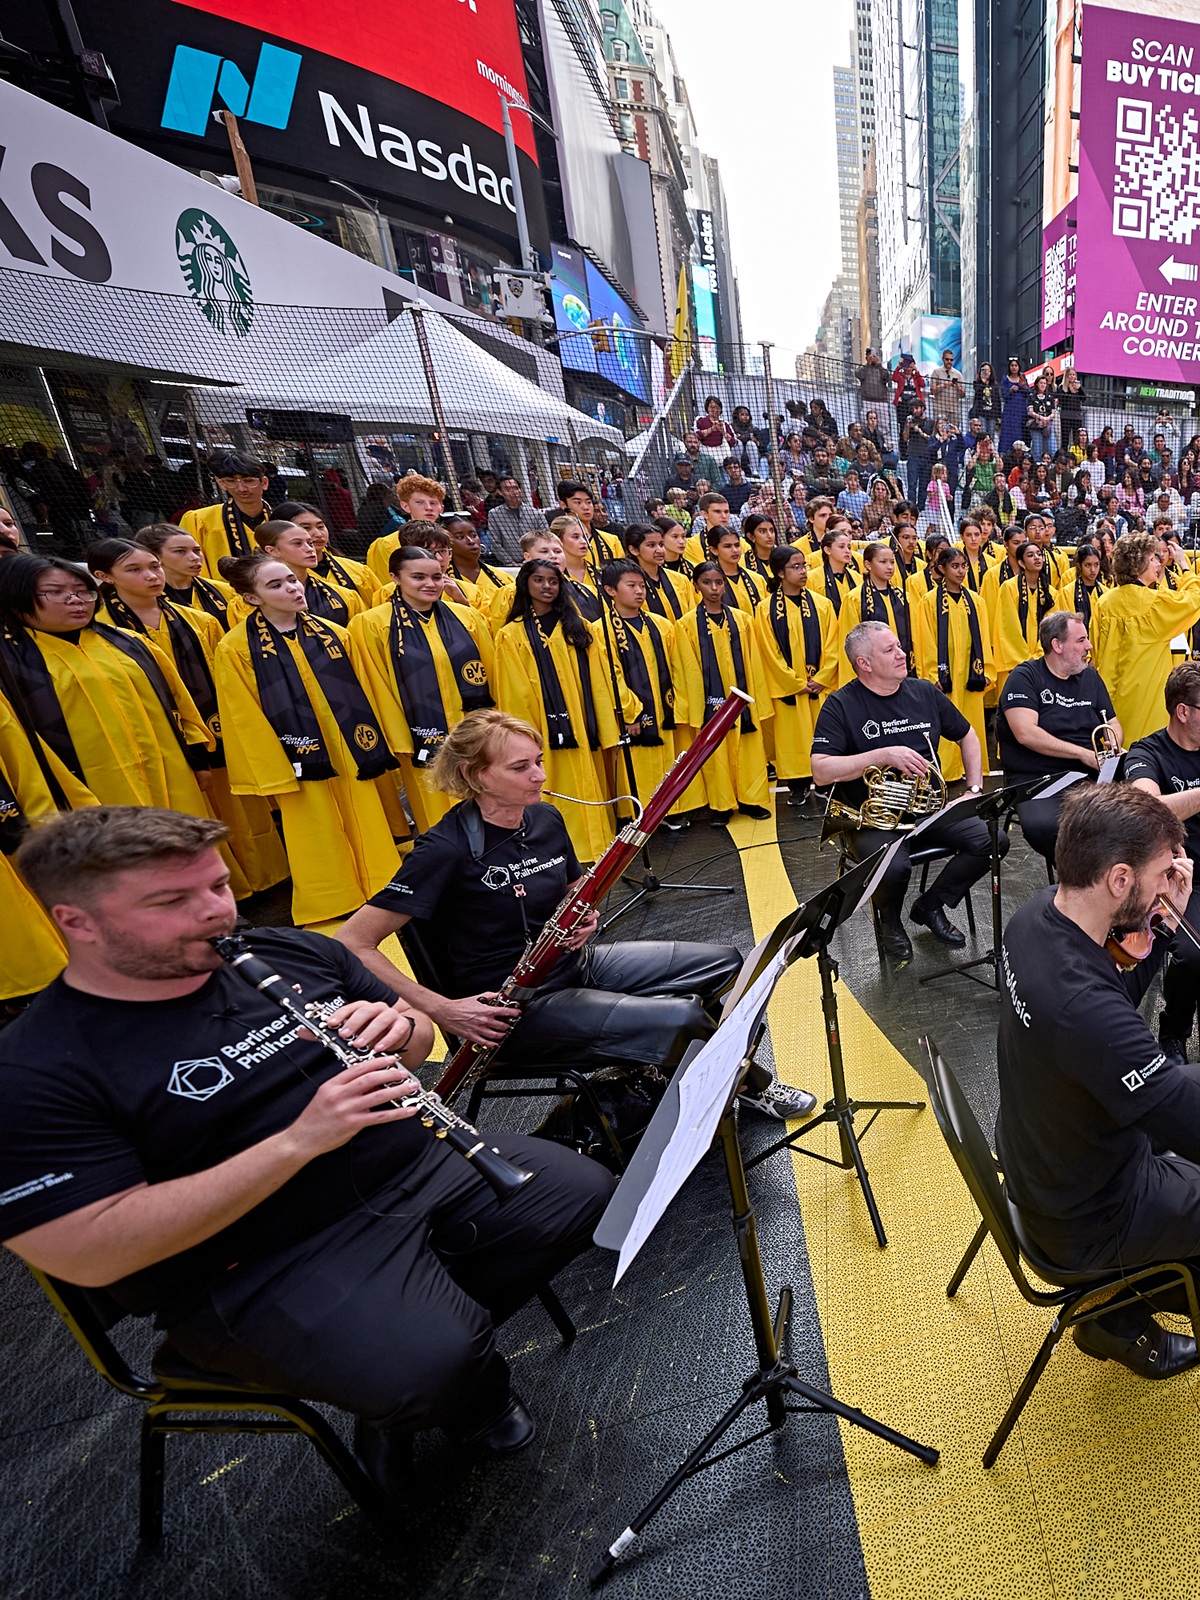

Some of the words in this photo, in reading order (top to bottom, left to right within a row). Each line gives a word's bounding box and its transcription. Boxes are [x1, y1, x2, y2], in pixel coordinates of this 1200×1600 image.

[1131, 37, 1194, 68] SCAN
[1106, 59, 1155, 88] BUY
[700, 213, 716, 261] Locker
[1136, 291, 1198, 316] ENTER
[1099, 311, 1188, 338] AROUND
[881, 717, 909, 728] Berliner
[883, 721, 932, 736] Philharmoniker
[296, 743, 321, 755] NYC
[220, 1012, 292, 1060] Berliner
